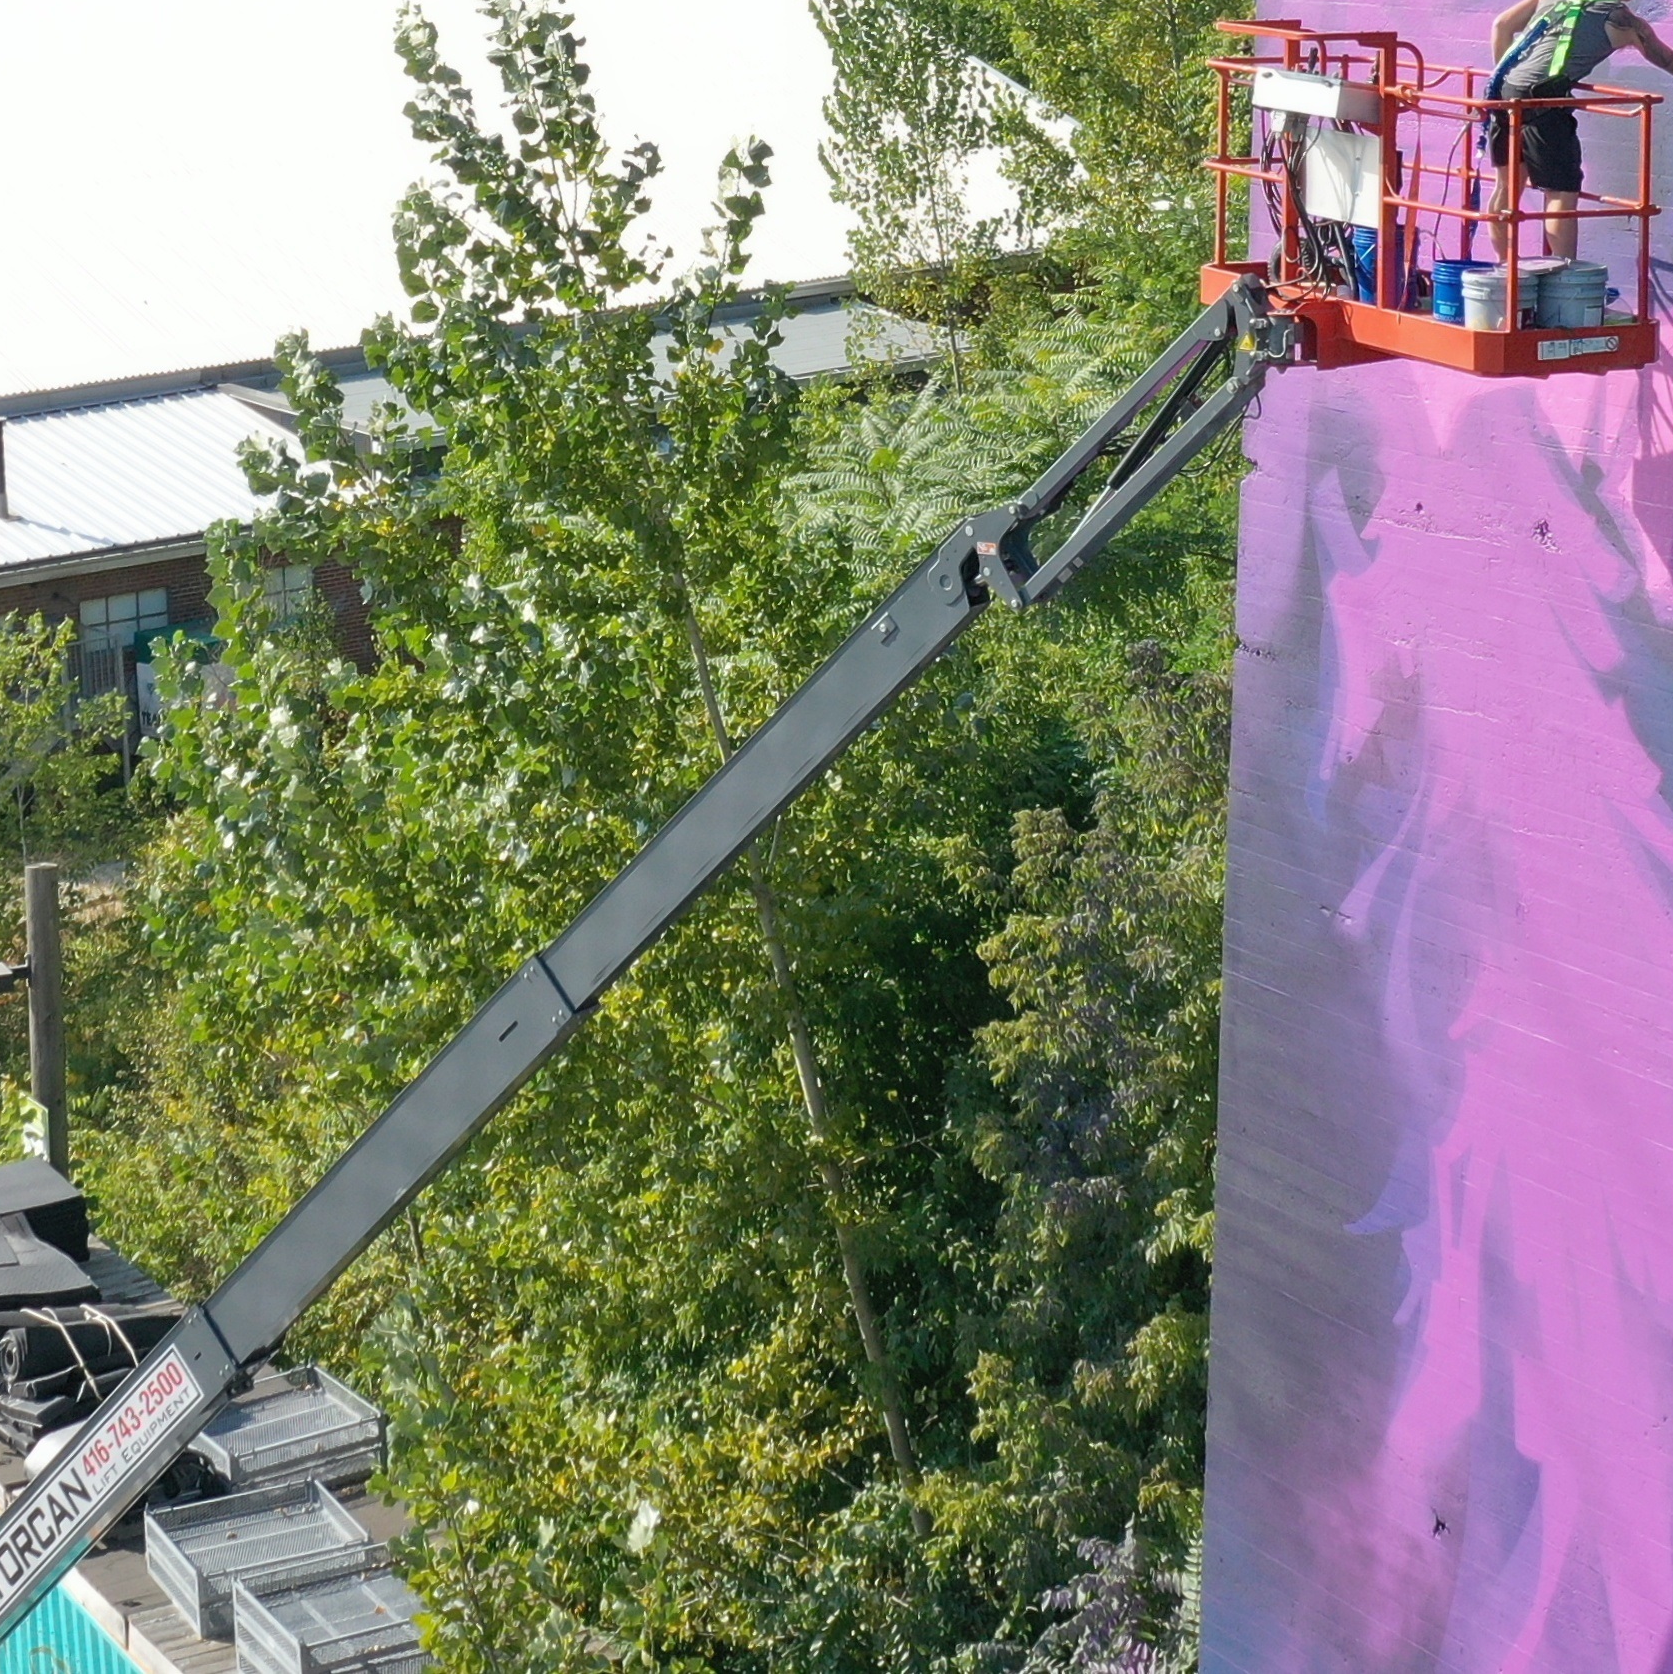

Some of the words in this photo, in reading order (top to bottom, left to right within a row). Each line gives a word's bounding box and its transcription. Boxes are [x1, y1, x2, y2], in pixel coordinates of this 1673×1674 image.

[81, 1360, 184, 1478] 416-743-2500
[91, 1465, 119, 1496] LIFT
[121, 1387, 191, 1466] EQUIPMENT
